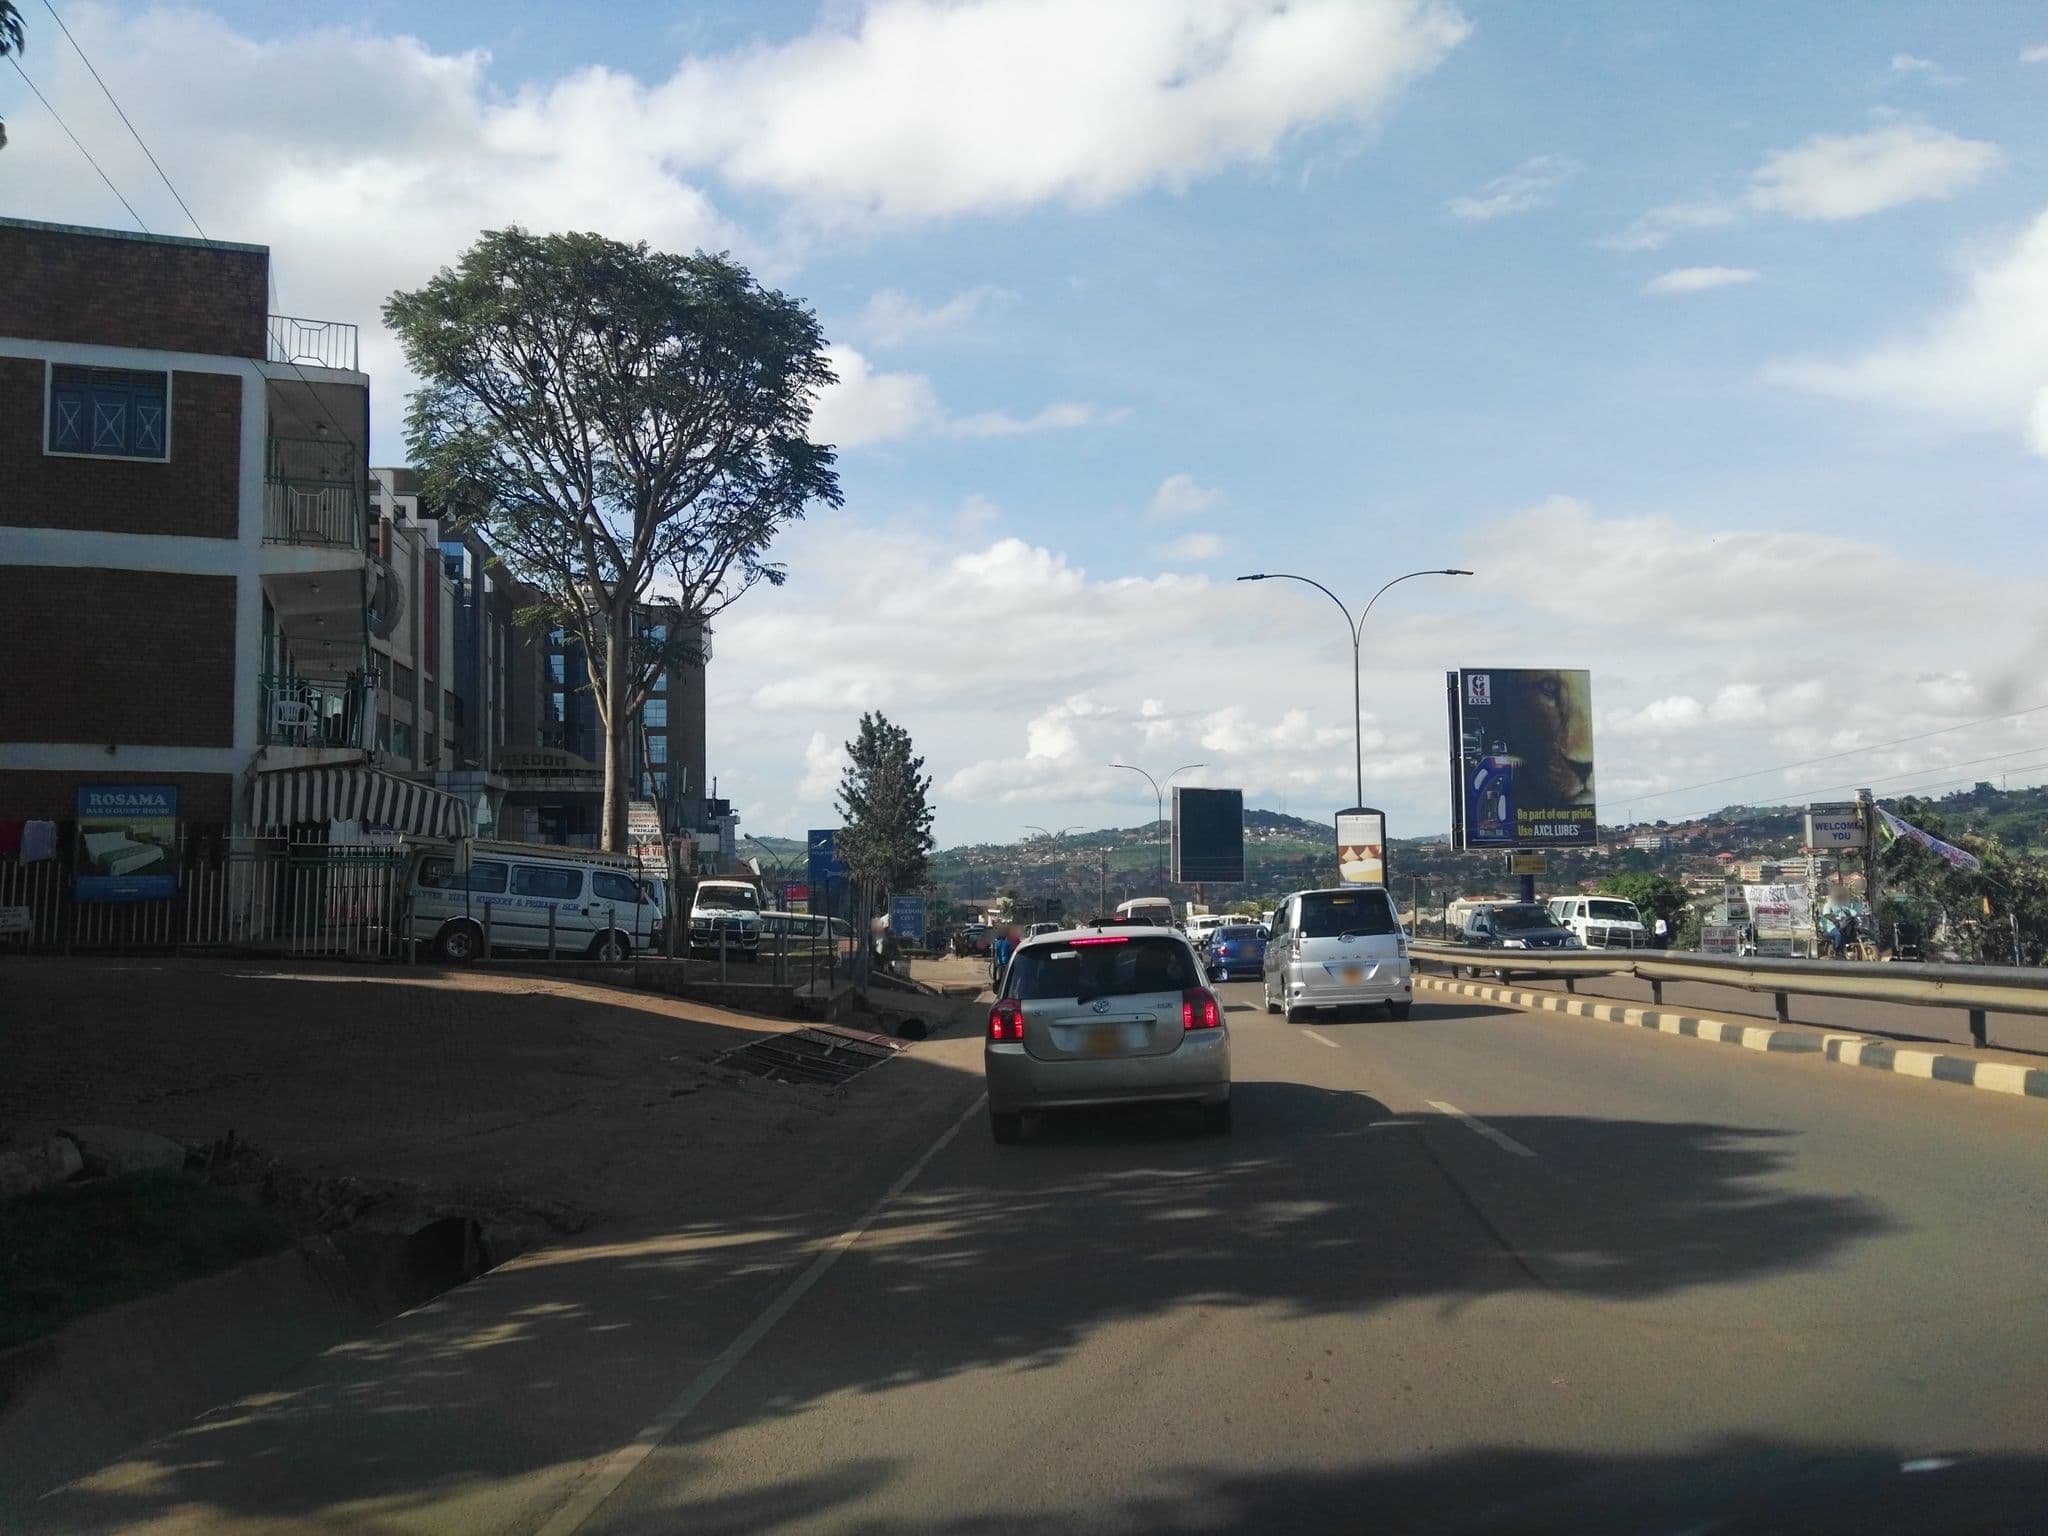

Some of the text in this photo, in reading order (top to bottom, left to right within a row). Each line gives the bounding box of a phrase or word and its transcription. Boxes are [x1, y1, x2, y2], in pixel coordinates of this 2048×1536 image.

[88, 793, 168, 806] ROSAMA
[113, 807, 141, 815] GUEST
[142, 807, 170, 815] HOUSE
[1516, 808, 1527, 819] Be
[1529, 809, 1546, 821] part
[1547, 808, 1556, 819] of
[1556, 810, 1569, 819] our
[1517, 825, 1533, 836] Use
[1534, 824, 1554, 836] AXCL
[1832, 832, 1851, 841] YOU
